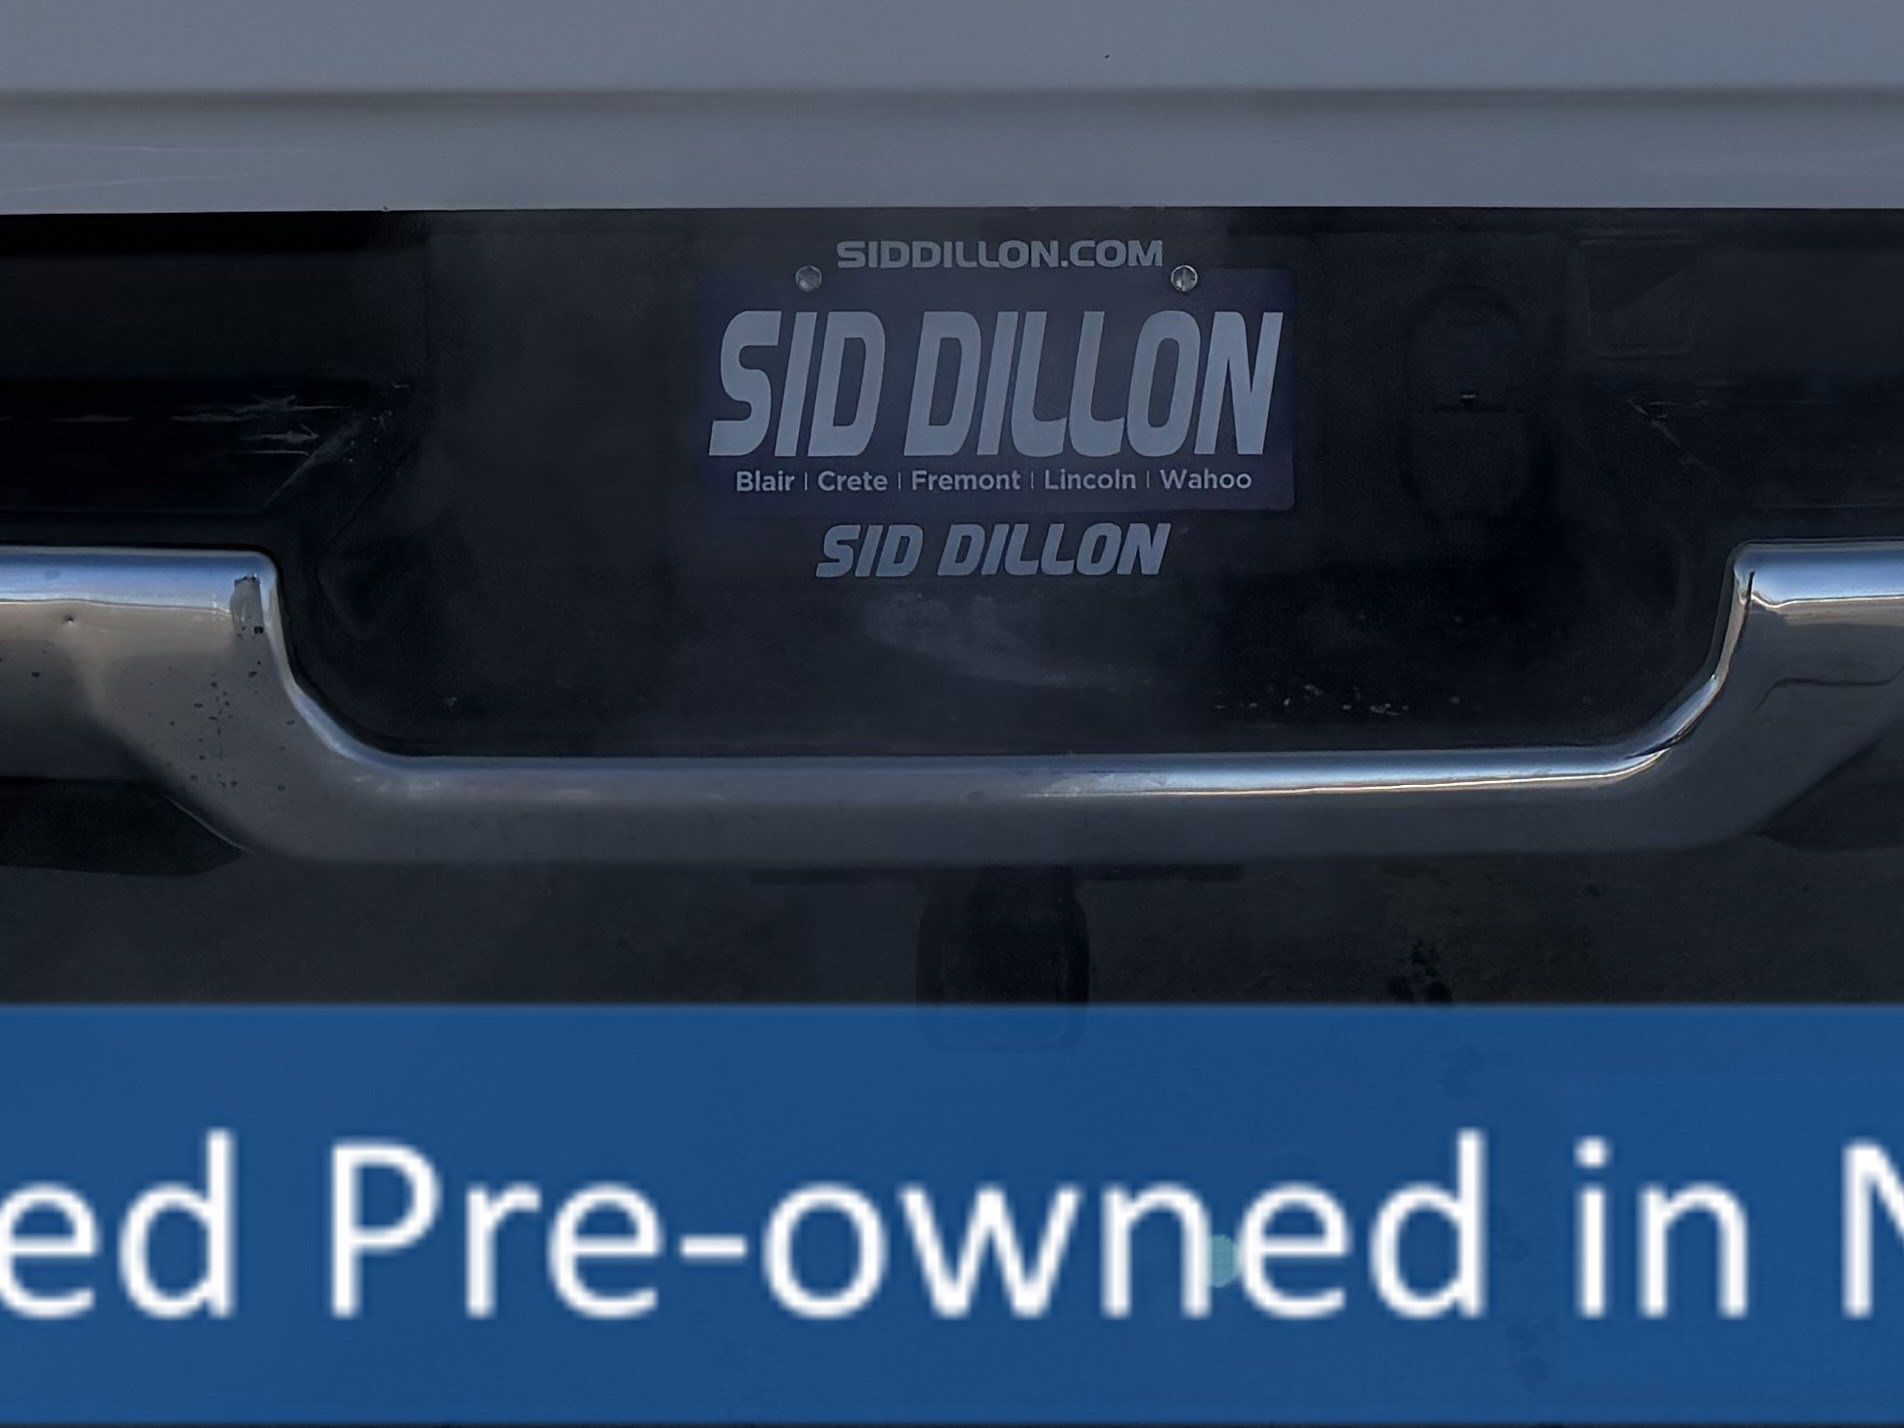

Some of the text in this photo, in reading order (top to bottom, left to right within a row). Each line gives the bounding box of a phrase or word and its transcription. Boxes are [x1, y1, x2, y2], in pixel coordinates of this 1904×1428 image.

[836, 239, 1164, 269] SIDDILLON.COM
[708, 310, 1284, 457] SID DILLON
[735, 468, 1253, 492] Blair Crete Fremont Lincoln Wahoo
[815, 522, 1172, 578] SID DILLON
